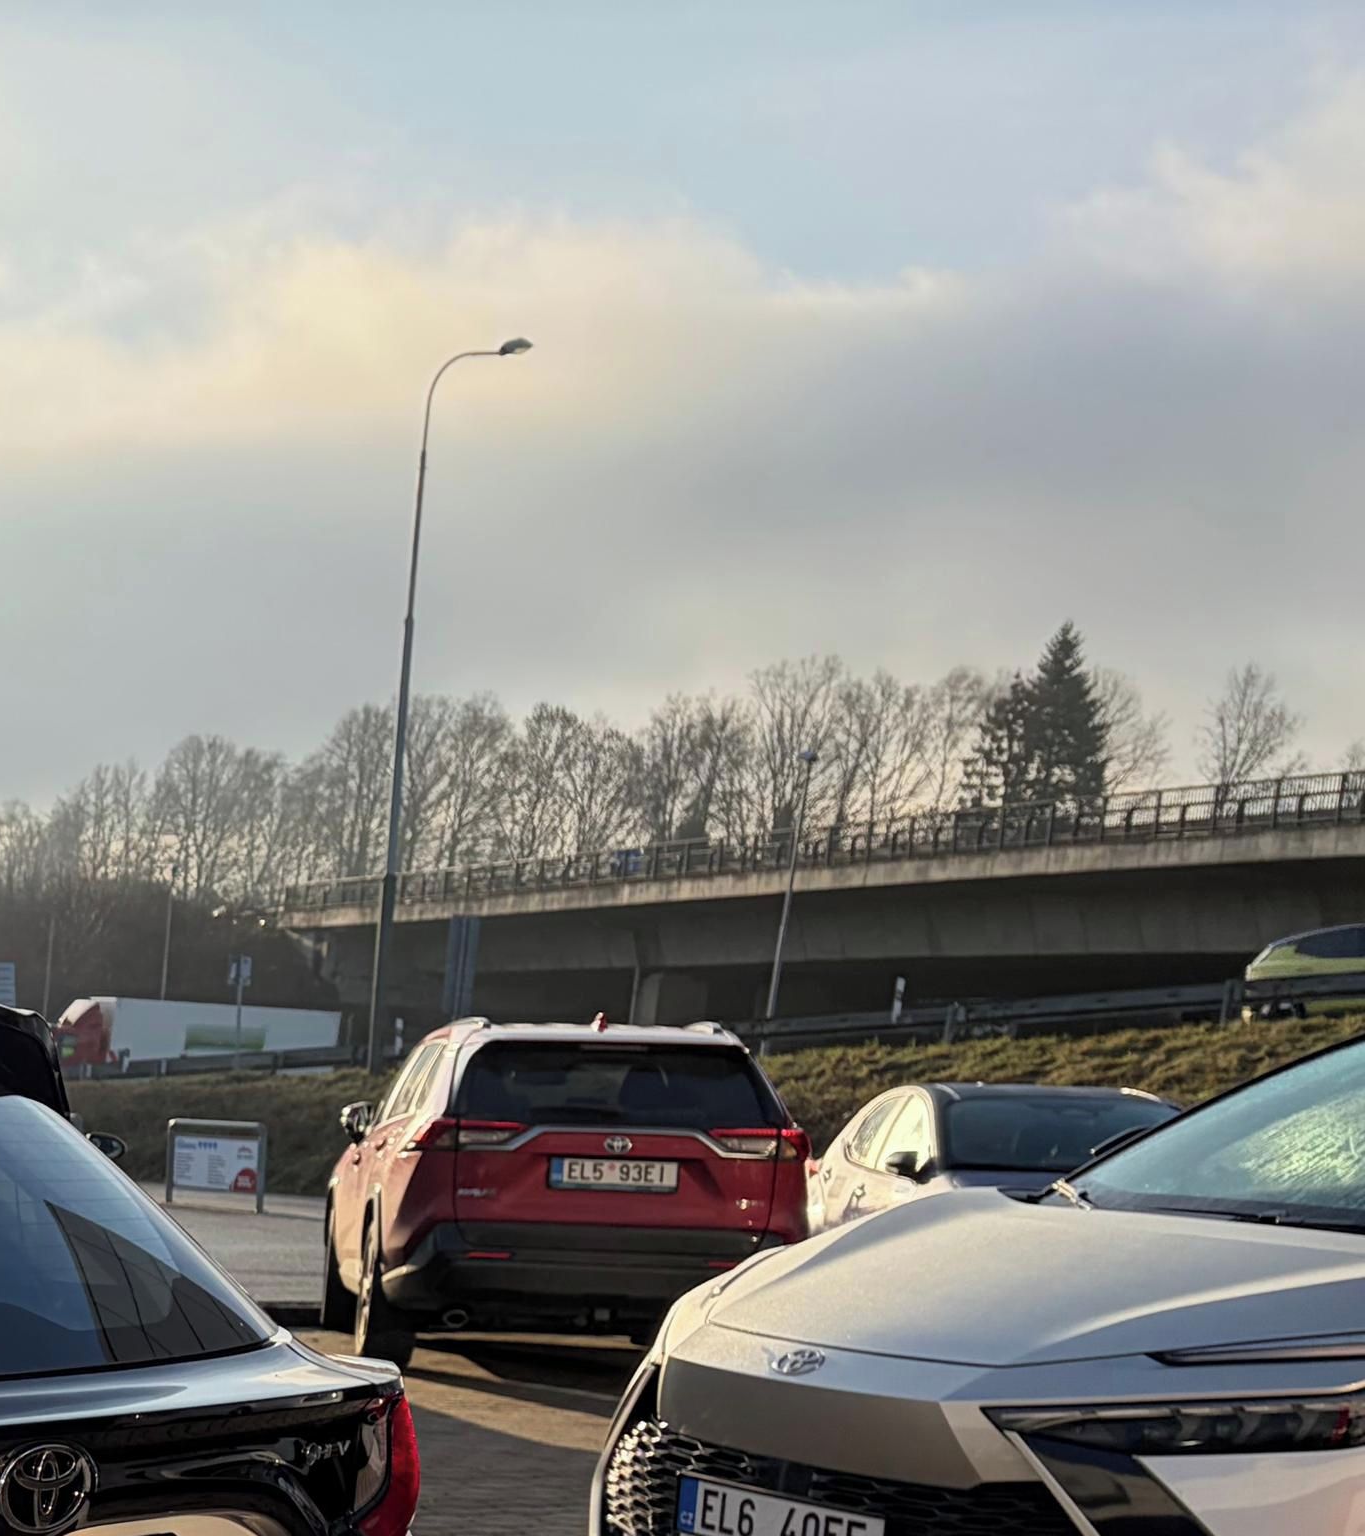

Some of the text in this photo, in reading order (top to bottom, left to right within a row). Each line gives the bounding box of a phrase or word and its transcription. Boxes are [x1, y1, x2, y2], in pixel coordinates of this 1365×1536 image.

[567, 1161, 665, 1184] EL5 93EI
[680, 1511, 694, 1526] CZ
